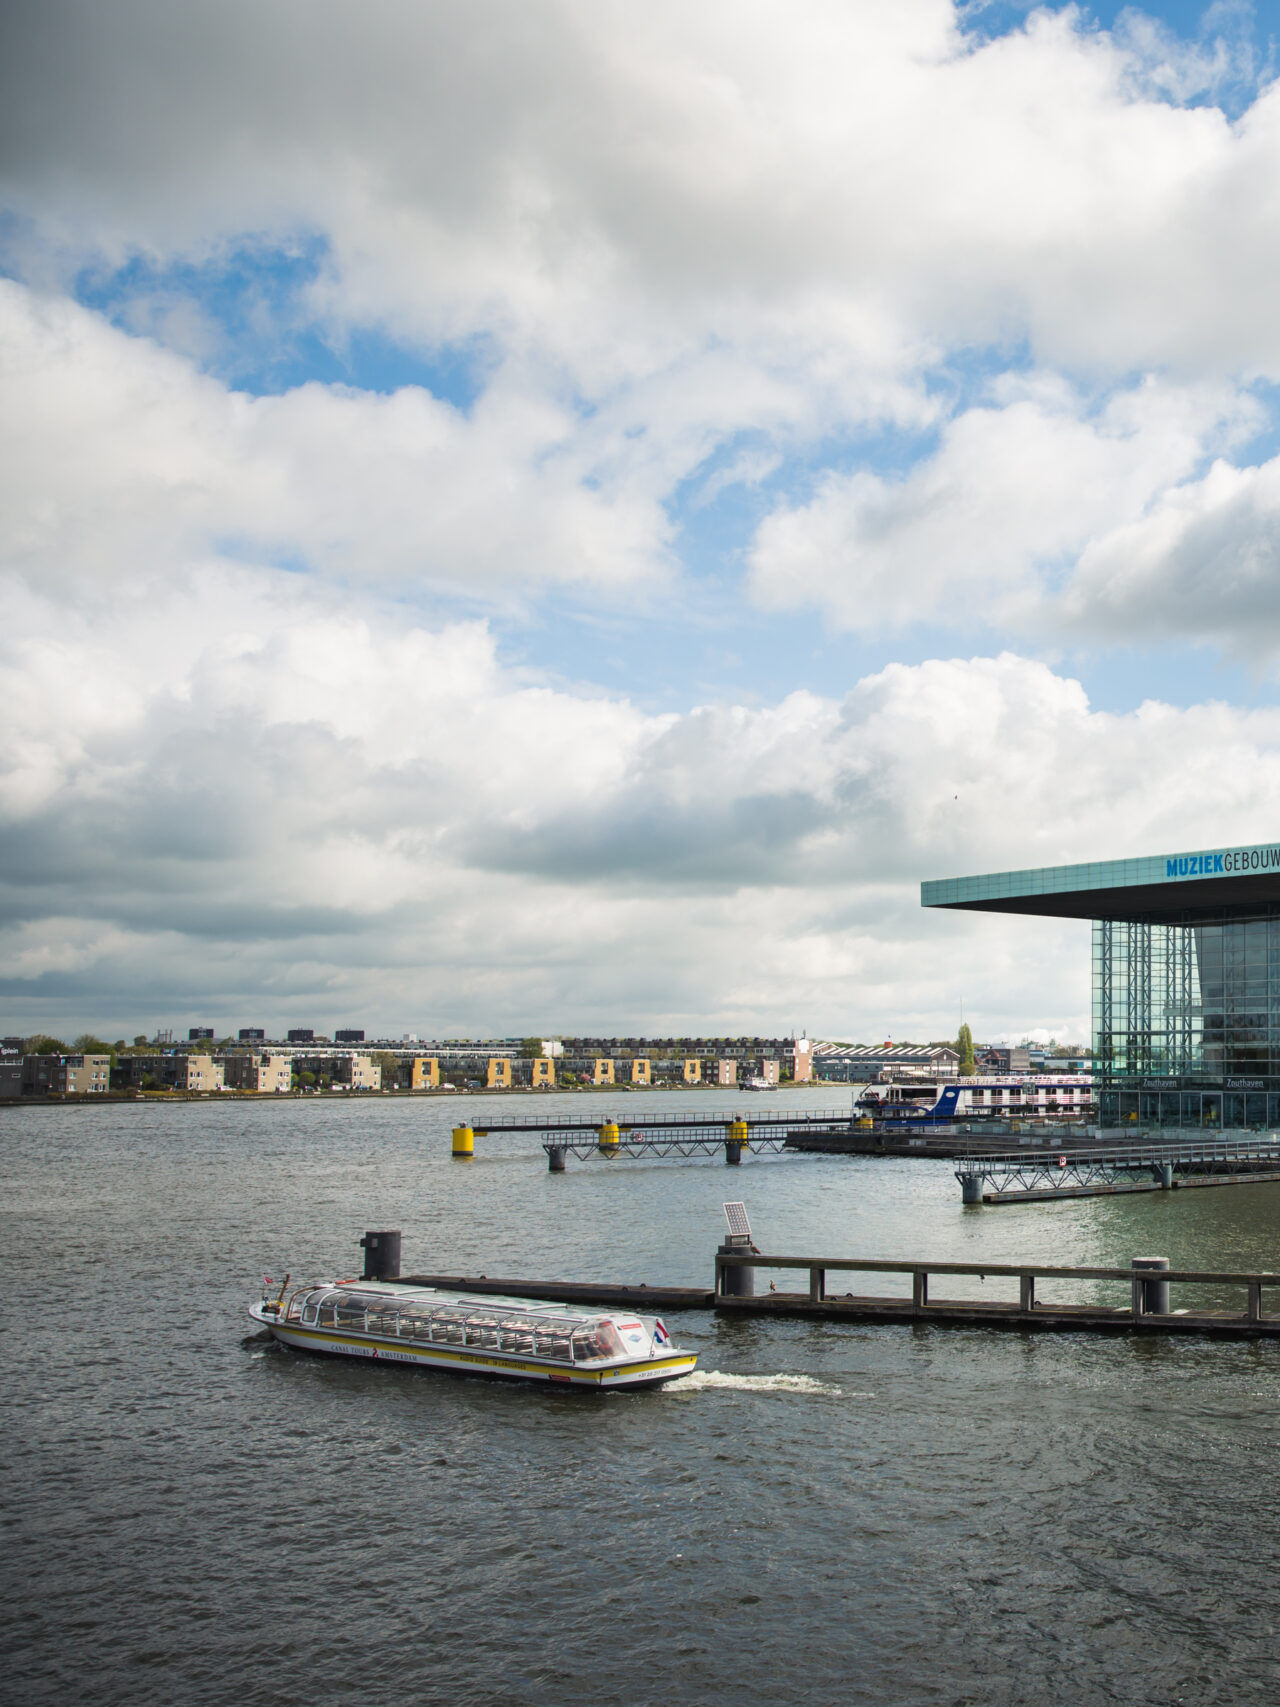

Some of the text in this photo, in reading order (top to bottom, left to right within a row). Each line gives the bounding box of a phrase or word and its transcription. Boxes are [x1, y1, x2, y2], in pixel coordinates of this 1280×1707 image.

[1143, 1078, 1177, 1088] Zouthaven
[1227, 1078, 1264, 1088] Zouthaven
[331, 1344, 349, 1353] CANAL
[352, 1346, 369, 1355] TOURS
[381, 1351, 417, 1361] AMSTERDAM
